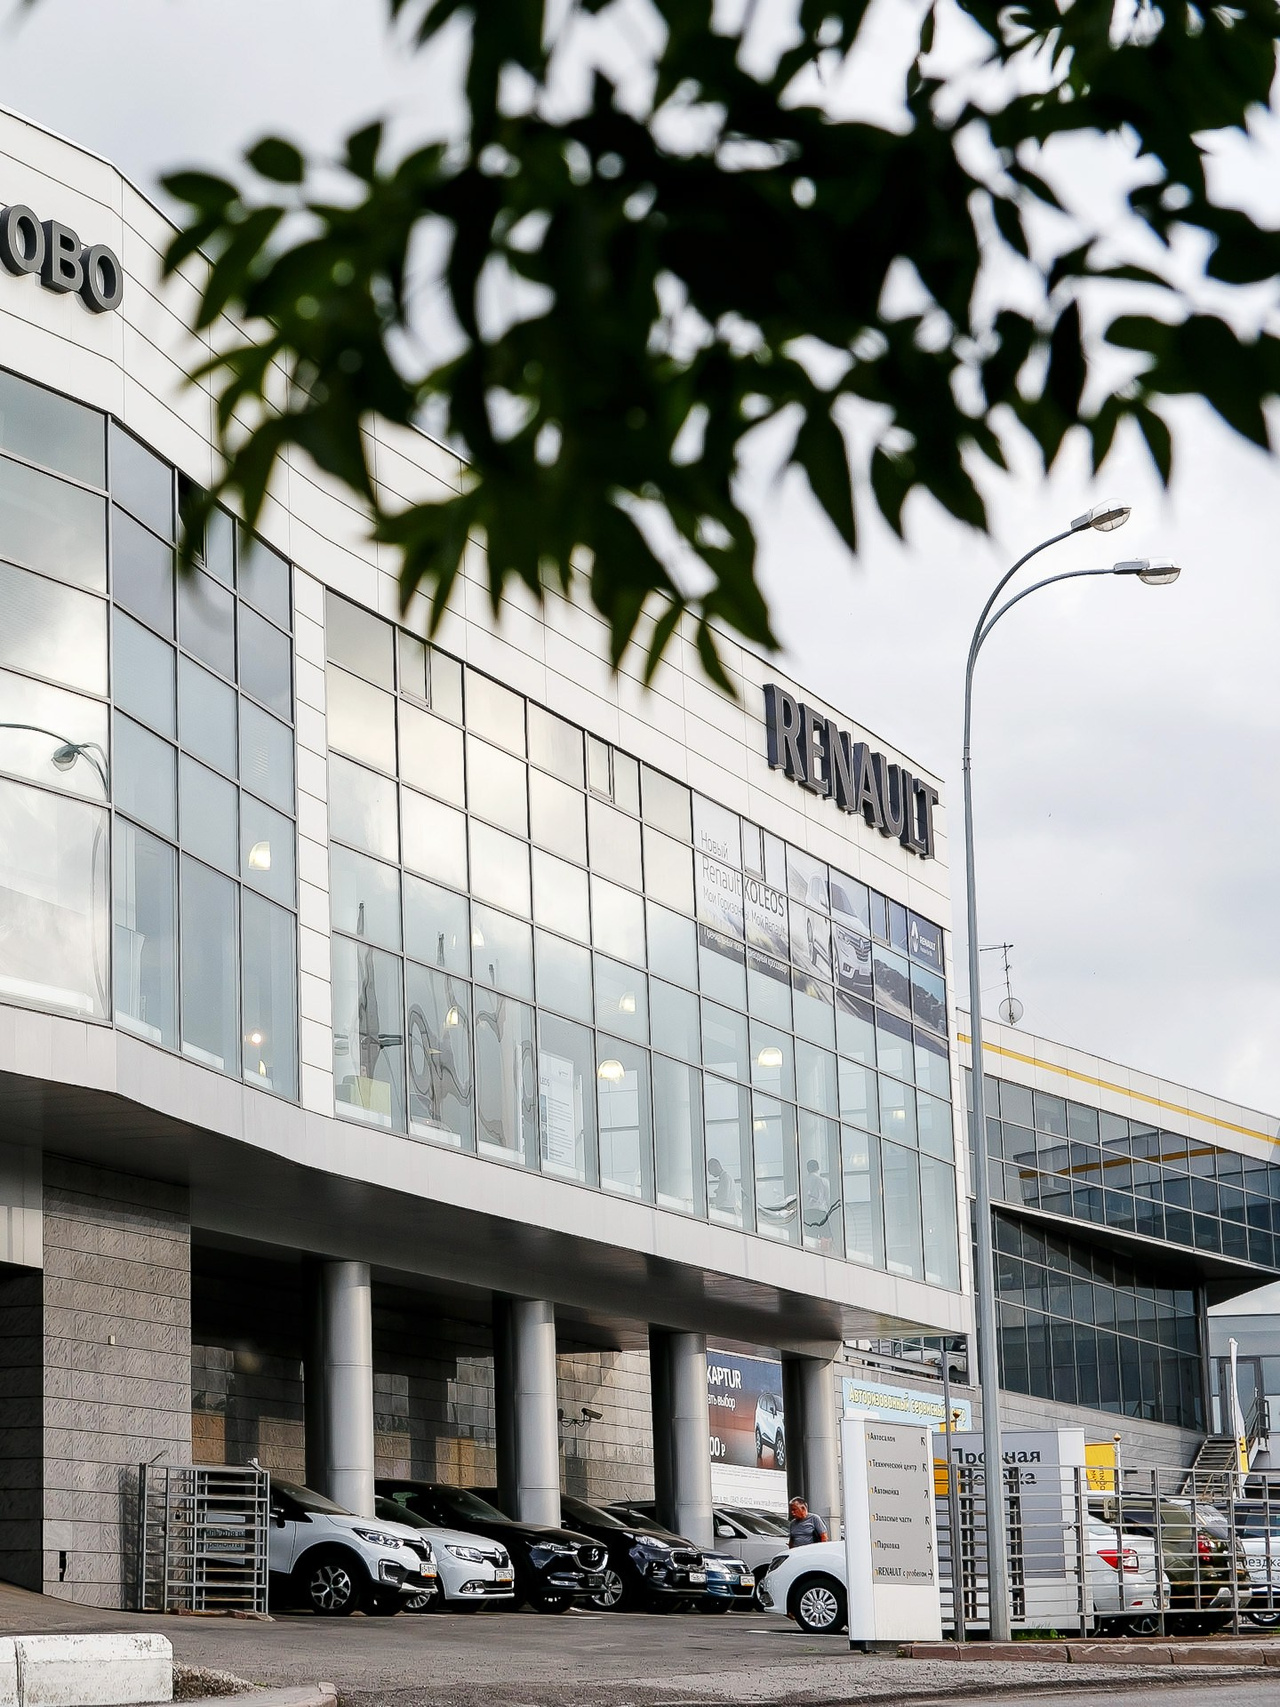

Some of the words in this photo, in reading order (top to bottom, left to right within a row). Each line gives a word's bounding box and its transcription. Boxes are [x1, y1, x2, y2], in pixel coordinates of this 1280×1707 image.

[763, 683, 939, 860] RENAULT
[701, 829, 728, 861] Новый
[702, 855, 742, 897] Renault
[744, 878, 785, 918] KOLEOS
[707, 1365, 742, 1390] KAPTUR
[870, 1432, 896, 1442] Автосалон
[872, 1459, 903, 1469] Технический
[874, 1486, 900, 1496] Автомойка
[875, 1513, 898, 1523] Запасные
[877, 1540, 900, 1550] Парковка
[878, 1567, 901, 1576] RENAULT
